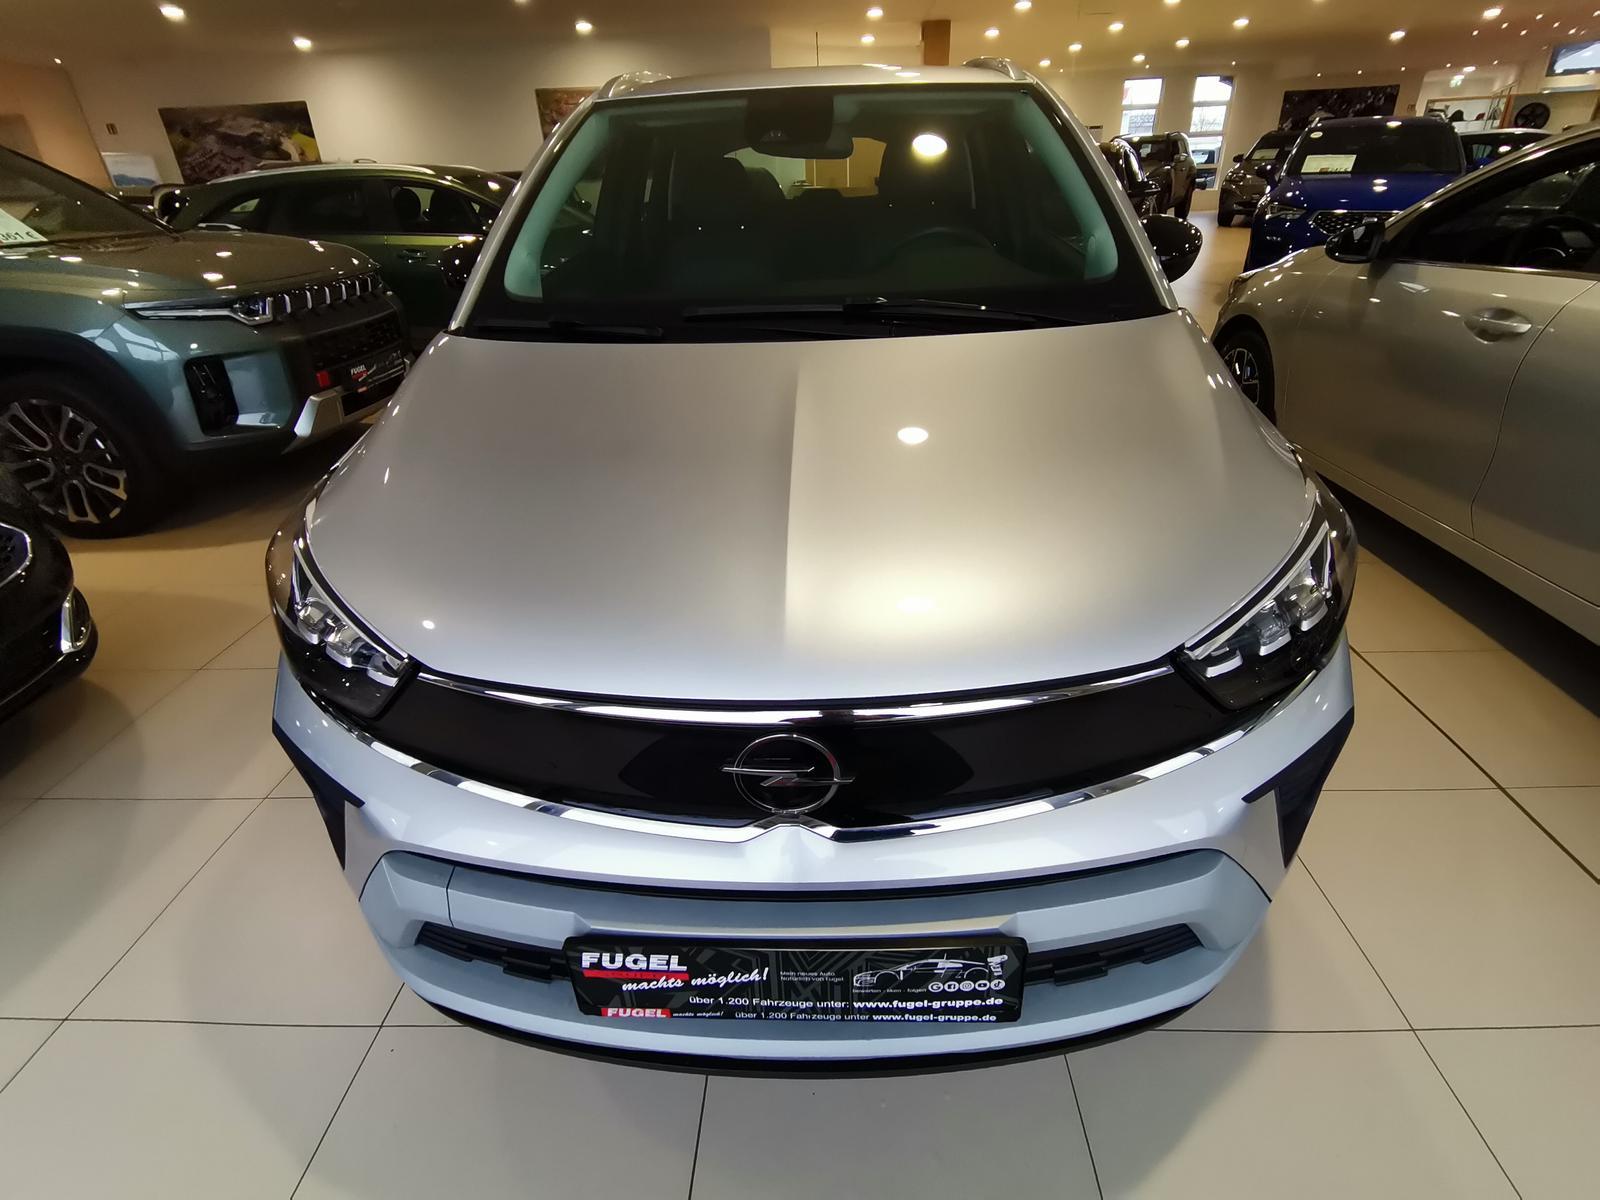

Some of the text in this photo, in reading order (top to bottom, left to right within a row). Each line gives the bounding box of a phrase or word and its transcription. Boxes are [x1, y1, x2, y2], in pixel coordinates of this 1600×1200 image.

[582, 952, 688, 972] FUGEL
[622, 967, 769, 991] machts möglich!
[689, 996, 1004, 1010] über 1.200 Fahrzeuge unter: www.fugel-gruppe.de
[607, 1008, 667, 1018] FUGEL
[735, 1011, 757, 1019] über
[761, 1012, 787, 1020] 1.200
[790, 1012, 842, 1021] Fahrzeuge
[844, 1013, 869, 1021] unter
[872, 1013, 997, 1022] www.fugel-gruppe.de
